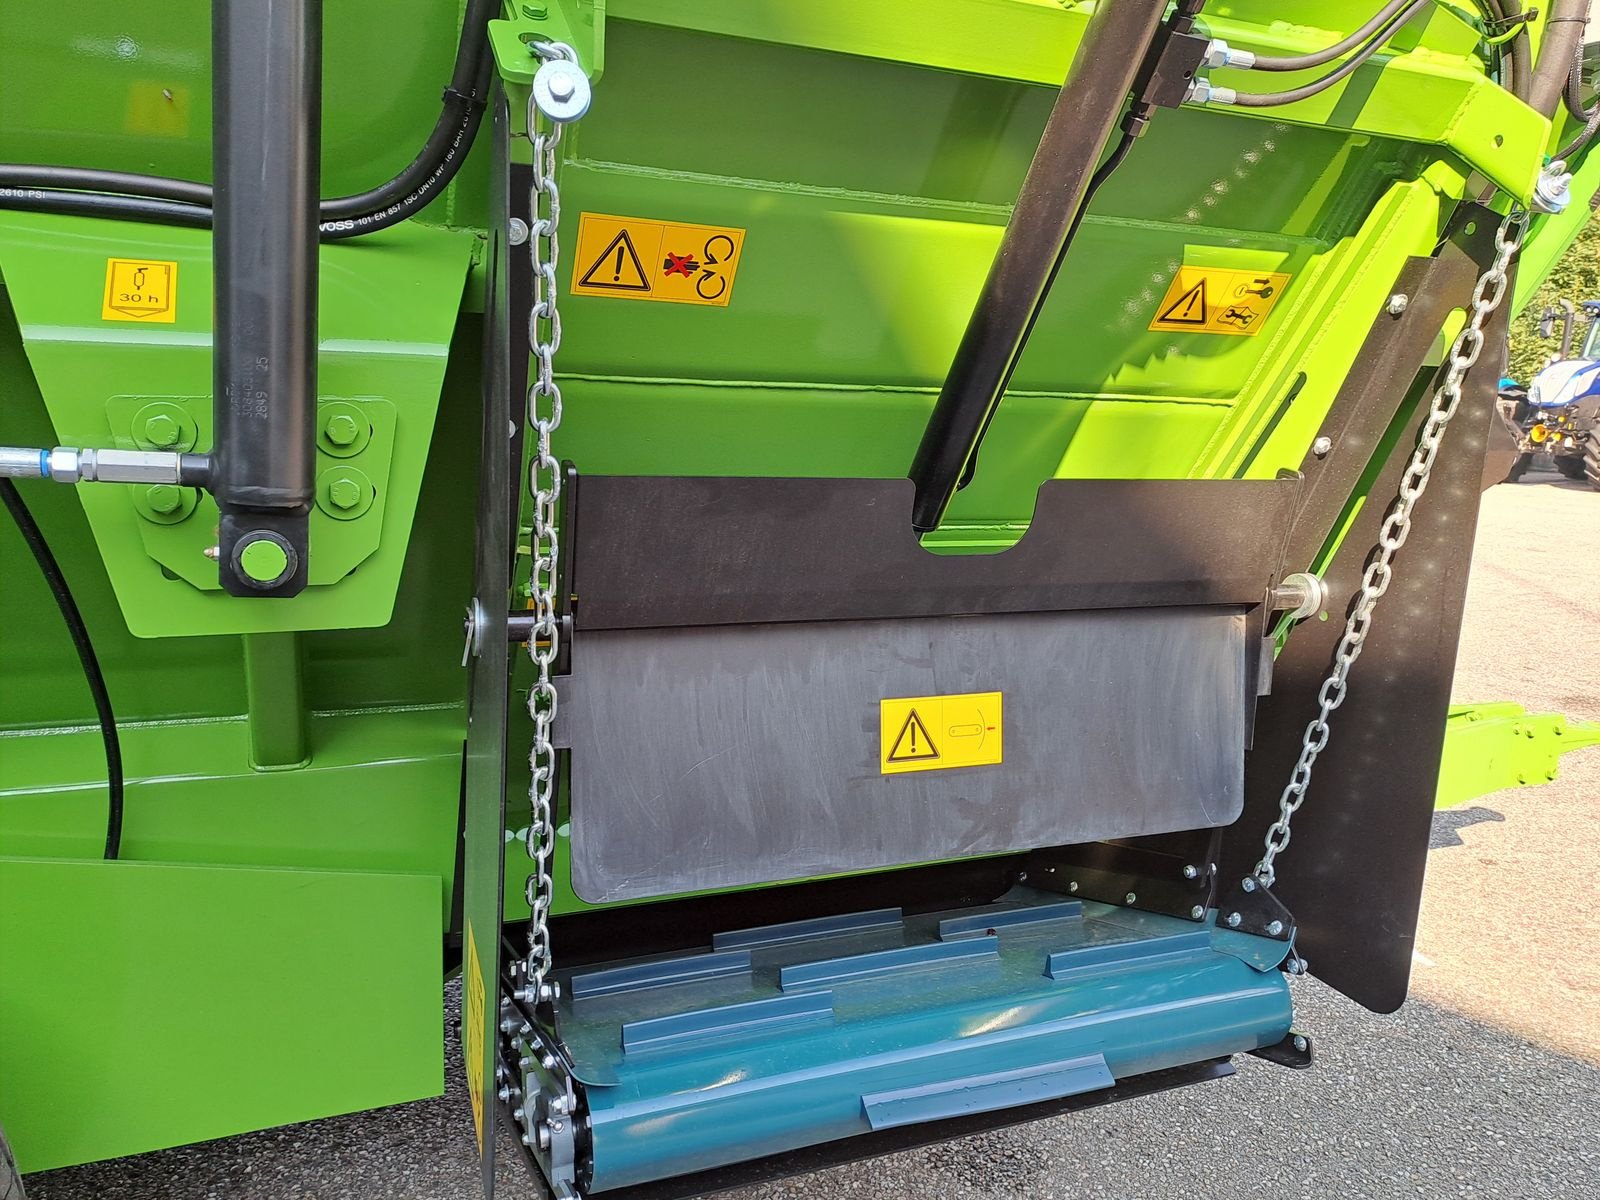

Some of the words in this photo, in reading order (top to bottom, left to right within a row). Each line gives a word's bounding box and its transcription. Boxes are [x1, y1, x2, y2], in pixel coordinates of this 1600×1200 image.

[28, 190, 46, 199] PSI
[319, 220, 354, 232] VOSS
[374, 211, 387, 221] EN
[387, 203, 401, 215] 857
[119, 293, 142, 303] 30
[148, 295, 158, 303] h
[255, 356, 268, 372] 25
